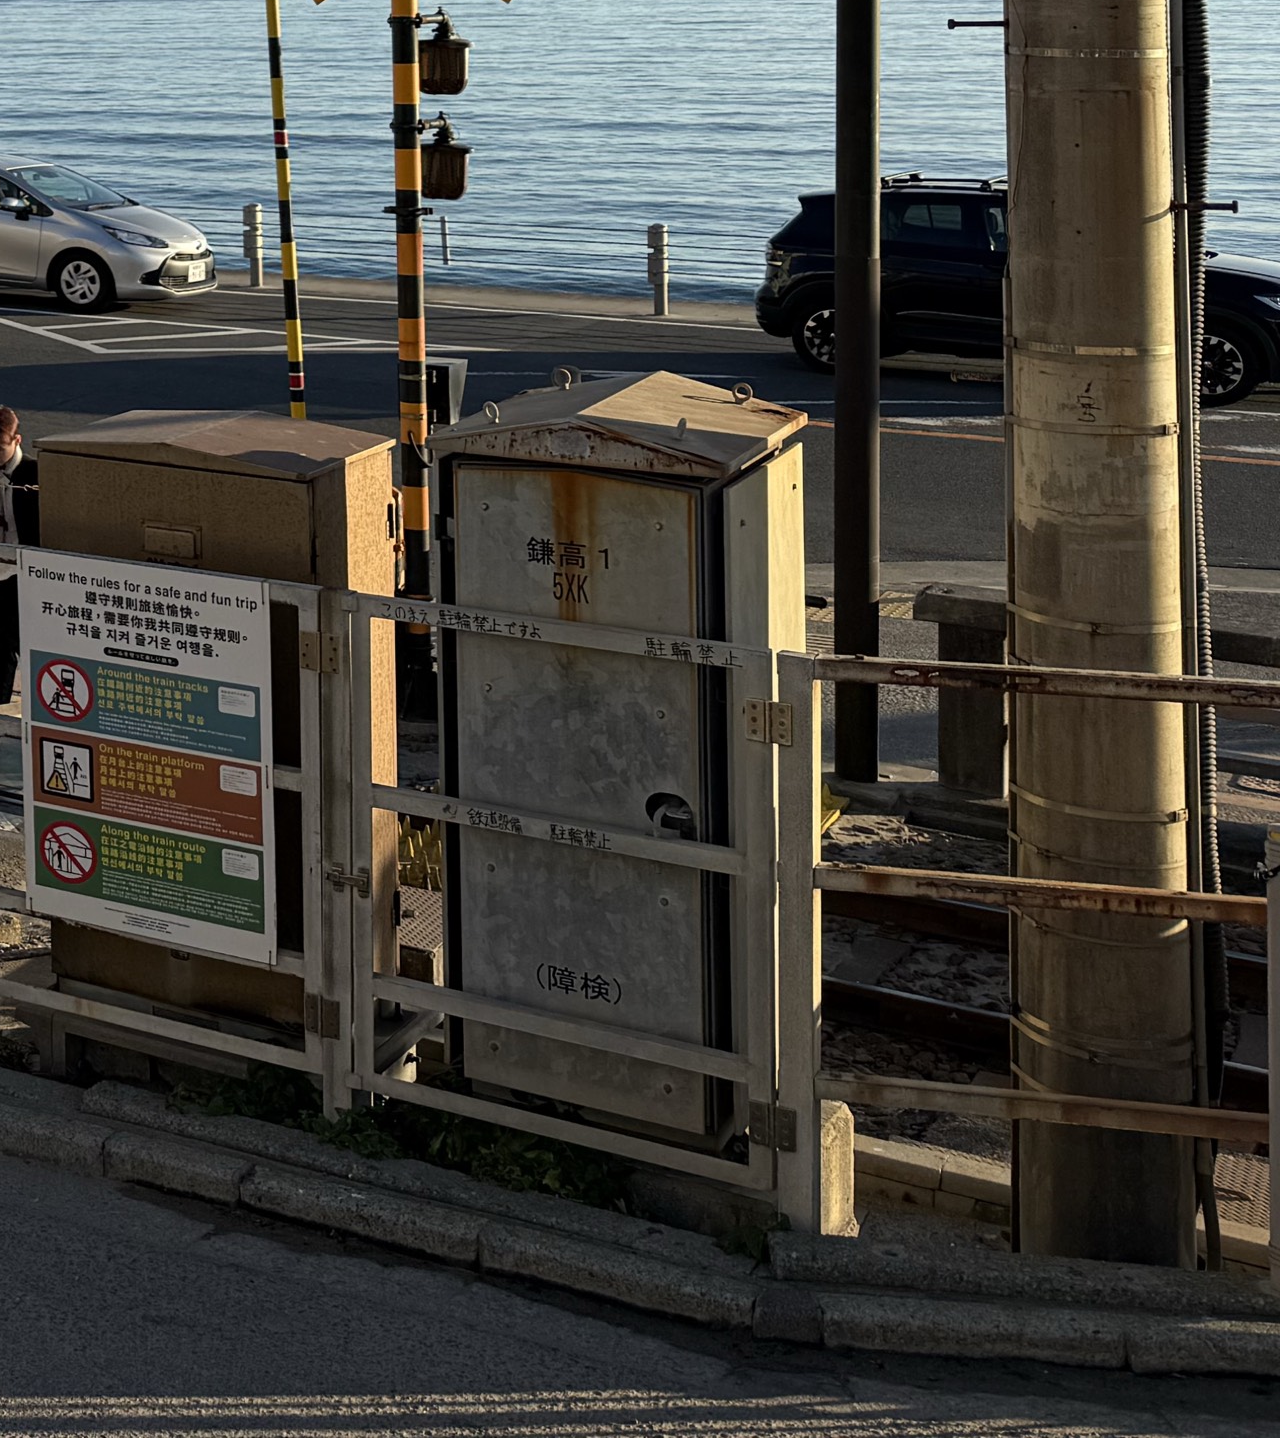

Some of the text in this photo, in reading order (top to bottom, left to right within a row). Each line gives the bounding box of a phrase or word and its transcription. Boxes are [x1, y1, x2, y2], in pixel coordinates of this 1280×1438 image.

[527, 536, 609, 570] 鎌高 1
[28, 566, 258, 612] Follow the rules for a safe and fun trip
[553, 572, 589, 604] 5XK
[66, 622, 219, 658] 규칙을 지켜 즐거운 여행을.
[644, 637, 743, 668] 駐輪禁止
[97, 666, 209, 694] Around the train tracks
[98, 743, 205, 771] On the train platform
[100, 824, 206, 854] Along the train route
[467, 807, 612, 850] 鉄道設備 駐輪禁止
[537, 963, 622, 1005] (障検)
